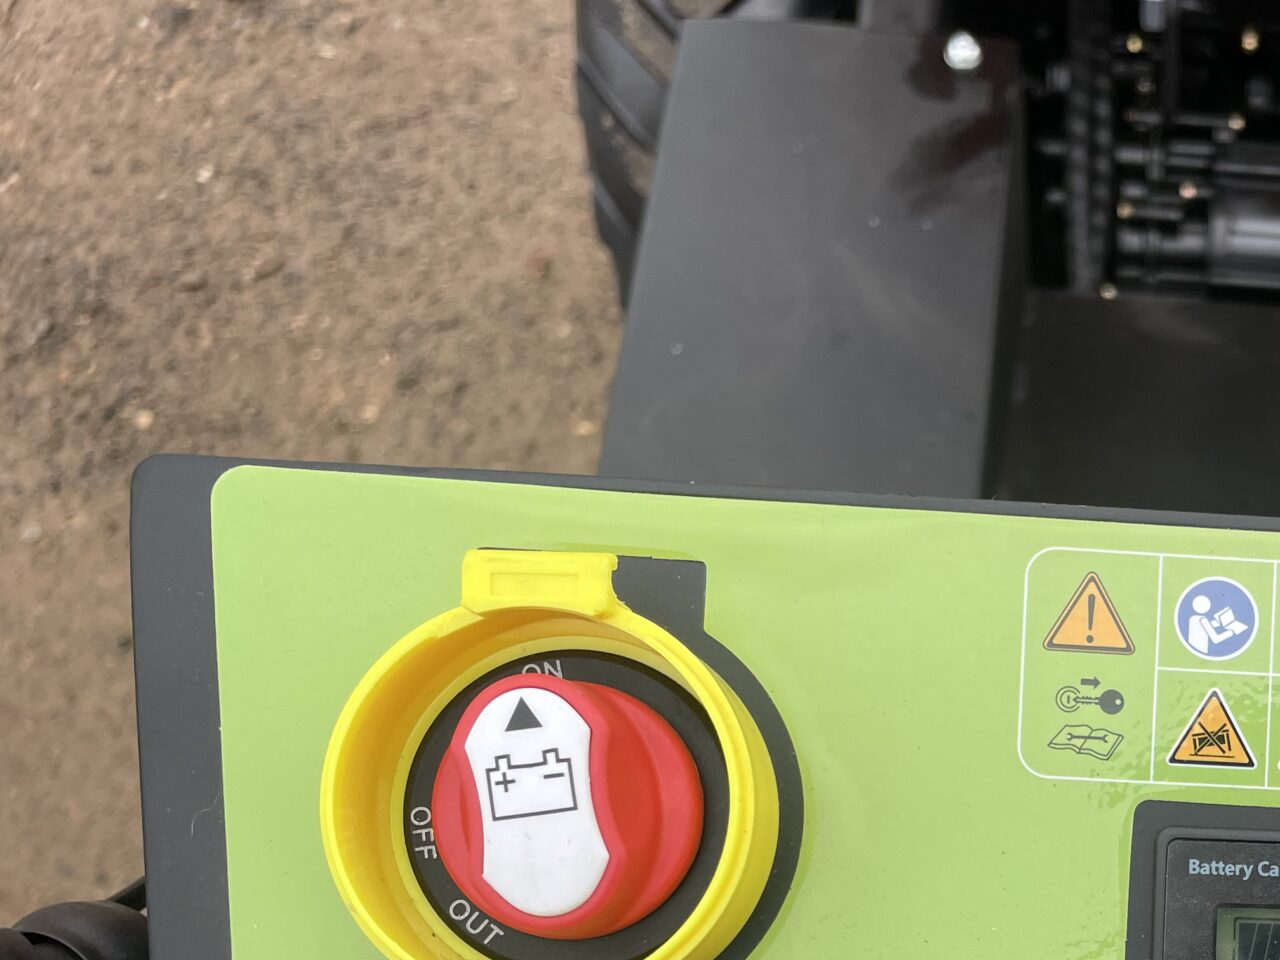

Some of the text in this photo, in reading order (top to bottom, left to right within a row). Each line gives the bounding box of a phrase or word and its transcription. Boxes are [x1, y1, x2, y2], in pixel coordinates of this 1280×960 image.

[410, 806, 438, 860] OFF
[1188, 858, 1254, 881] Battery
[448, 899, 505, 945] OUT
